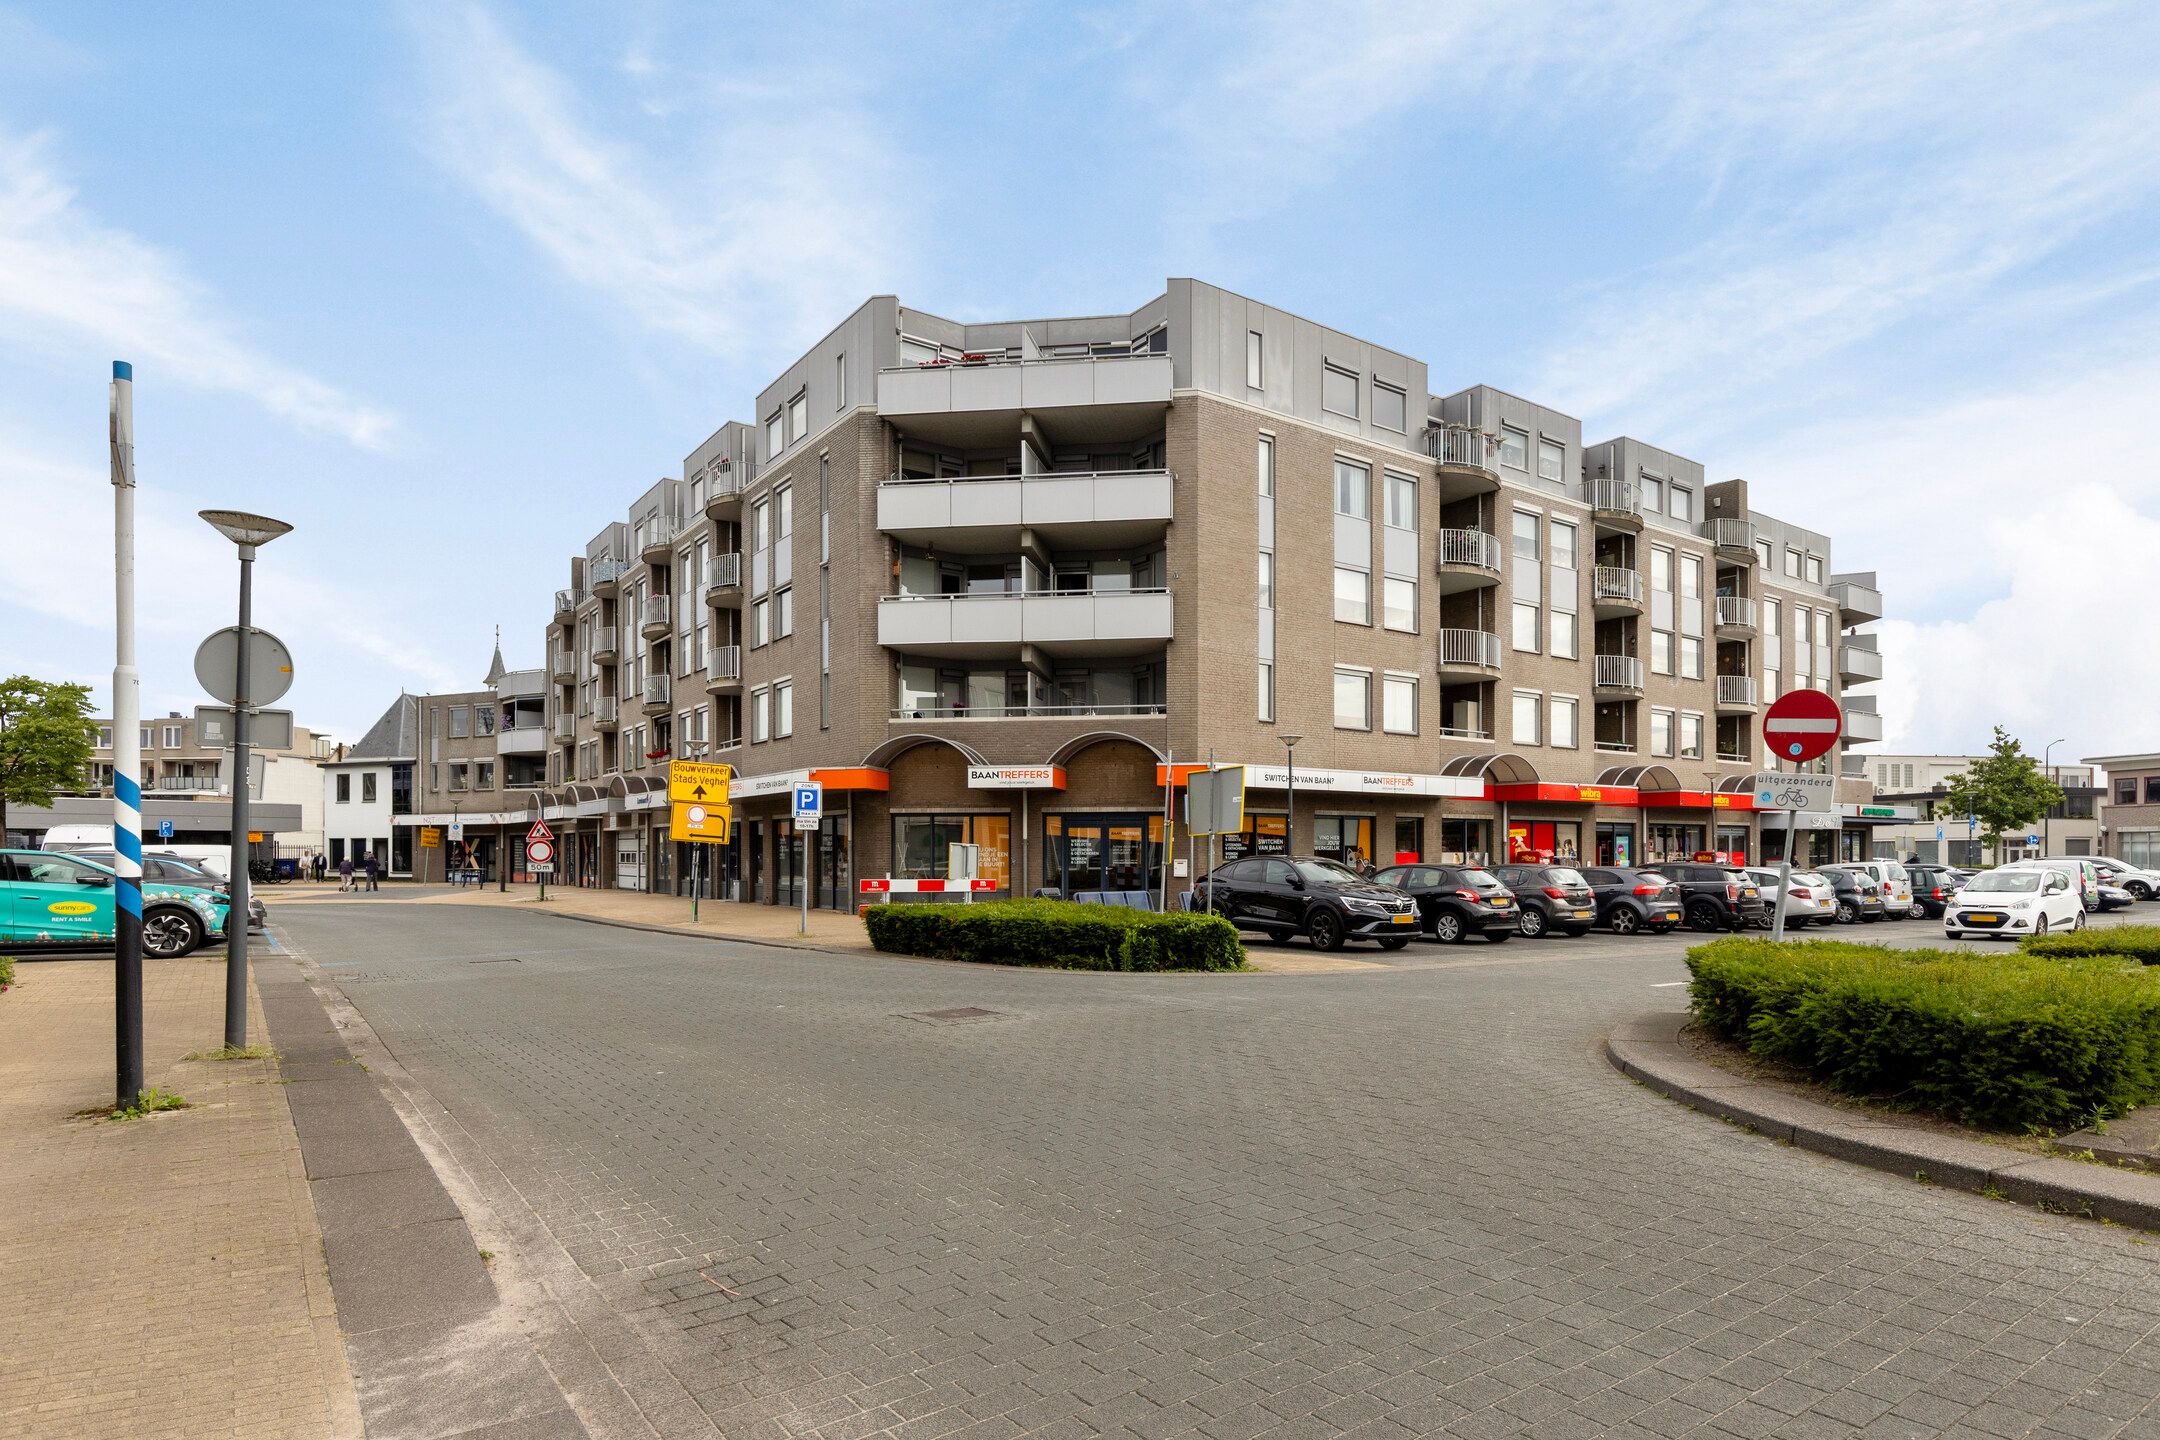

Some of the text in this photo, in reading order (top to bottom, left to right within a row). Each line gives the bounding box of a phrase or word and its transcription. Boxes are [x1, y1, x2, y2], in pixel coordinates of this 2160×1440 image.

[674, 763, 728, 775] Bouwverkeer
[971, 770, 1050, 780] BAANTREFFERS
[1264, 774, 1300, 782] SWITCHEN
[674, 774, 697, 784] Stads
[700, 776, 728, 788] Veghel
[1364, 776, 1414, 786] BAANTREFFERS
[1758, 775, 1832, 787] uitgezonderd
[1580, 788, 1600, 798] wibra
[802, 792, 814, 808] P
